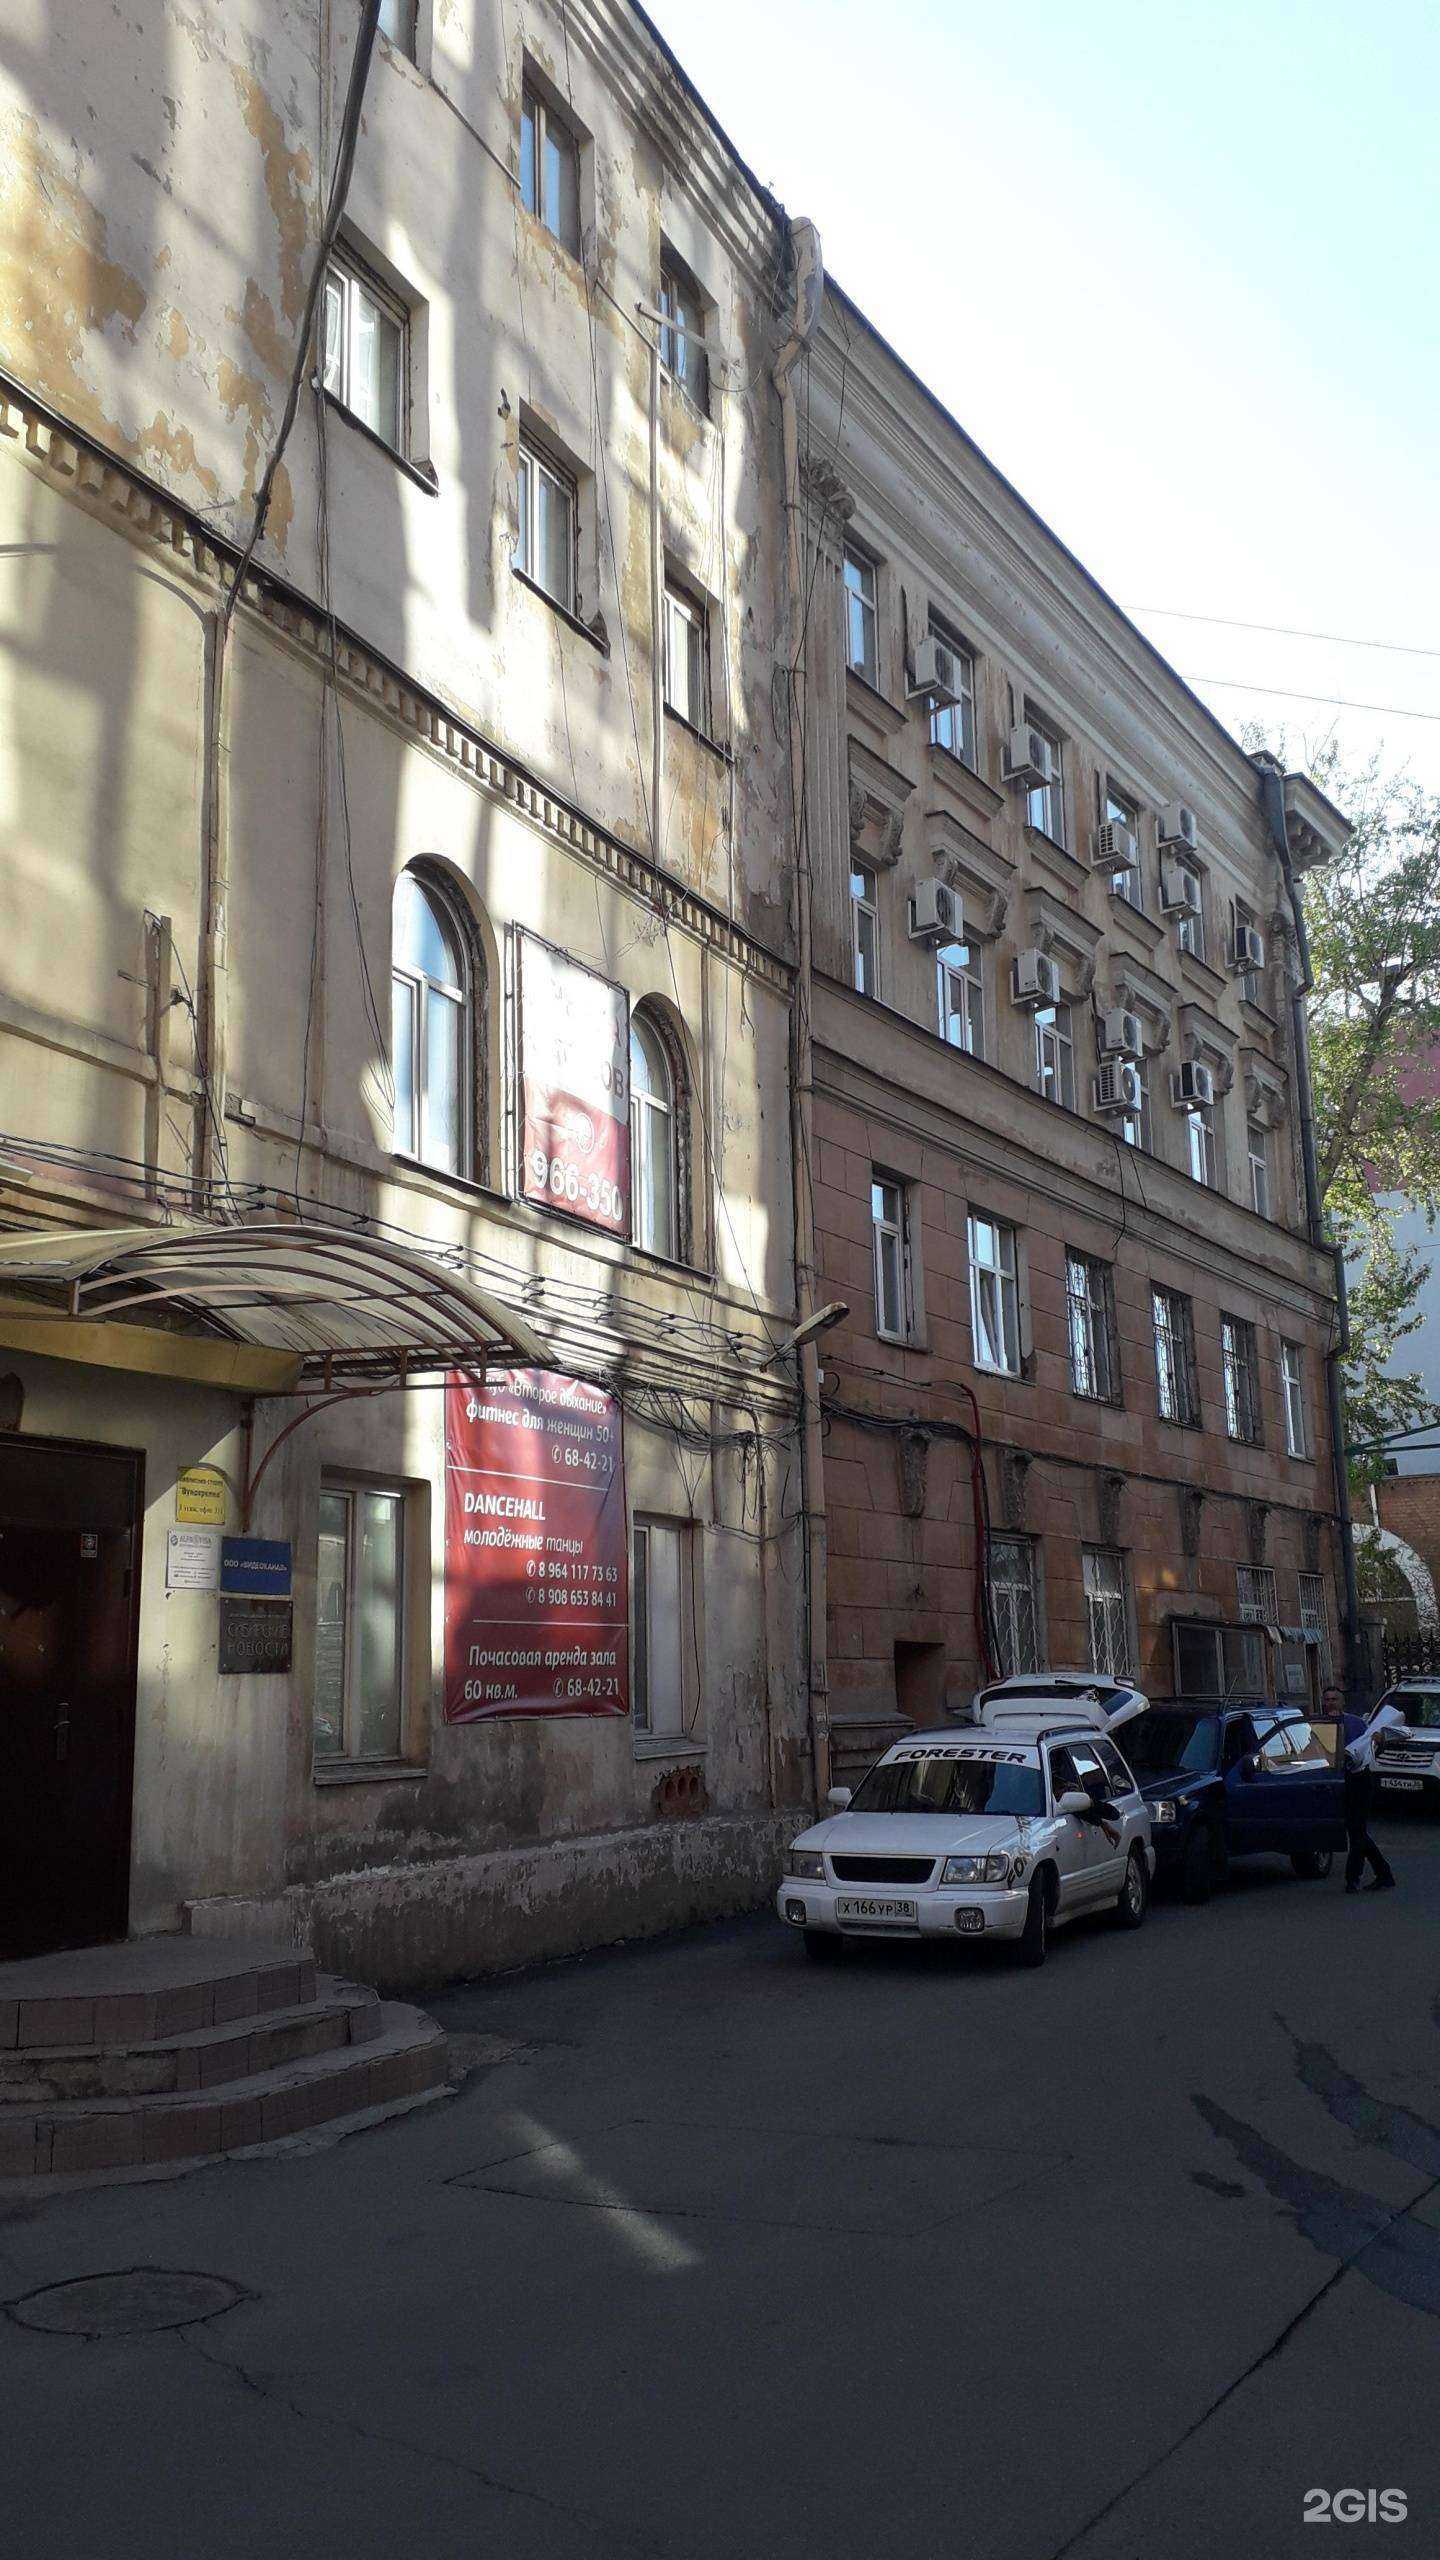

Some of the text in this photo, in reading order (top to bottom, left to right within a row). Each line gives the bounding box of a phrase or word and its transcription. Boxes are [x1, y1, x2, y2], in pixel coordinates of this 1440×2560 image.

[559, 1387, 607, 1415] дыхание»
[466, 1398, 518, 1427] фитнес
[521, 1408, 544, 1431] для
[547, 1418, 594, 1443] женщин
[564, 1450, 614, 1474] 68-42-21
[463, 1492, 546, 1521] DANCEHALL
[463, 1526, 584, 1559] молодёжные танцы
[538, 1562, 618, 1583] 8 964 117 73 63
[538, 1588, 617, 1607] 8 908 653 84 41
[469, 1645, 617, 1671] Почасовая аренда зала
[464, 1679, 482, 1700] 60
[566, 1678, 619, 1698] 68-42-21
[894, 1748, 1028, 1764] FORESTER
[896, 1902, 911, 1914] 38
